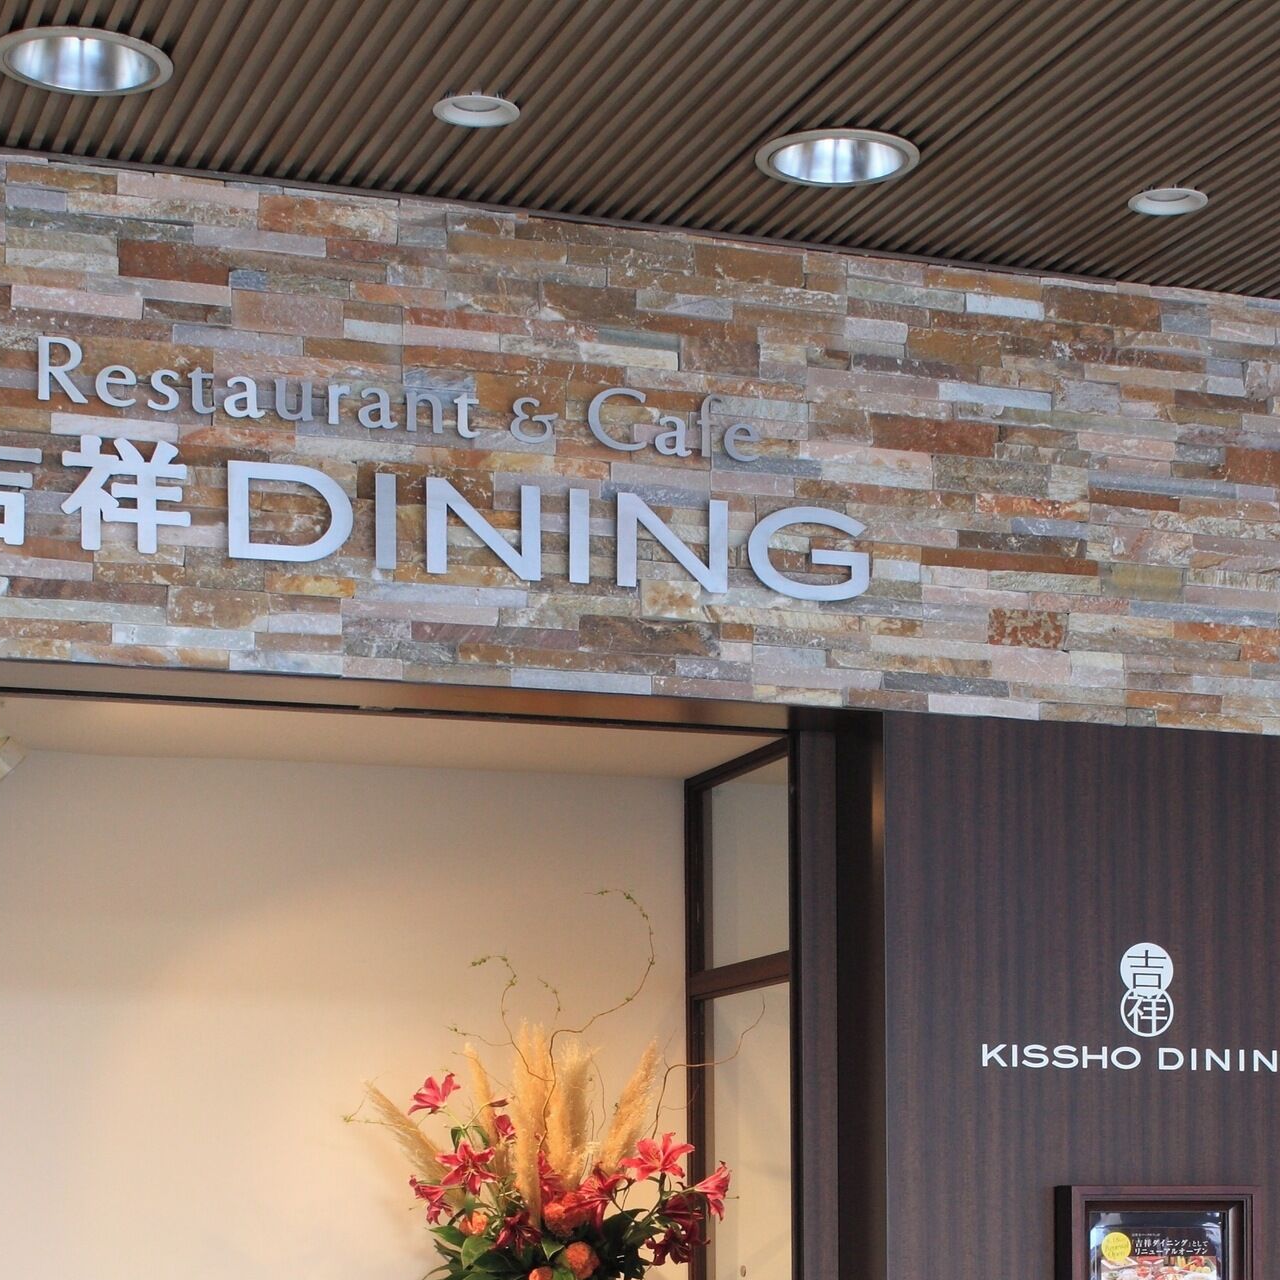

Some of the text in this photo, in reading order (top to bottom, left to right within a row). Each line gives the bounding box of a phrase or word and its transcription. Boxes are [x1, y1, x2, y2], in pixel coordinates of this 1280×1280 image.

[35, 335, 760, 462] Restaurant & Cafe
[981, 1043, 1142, 1070] KISSHO
